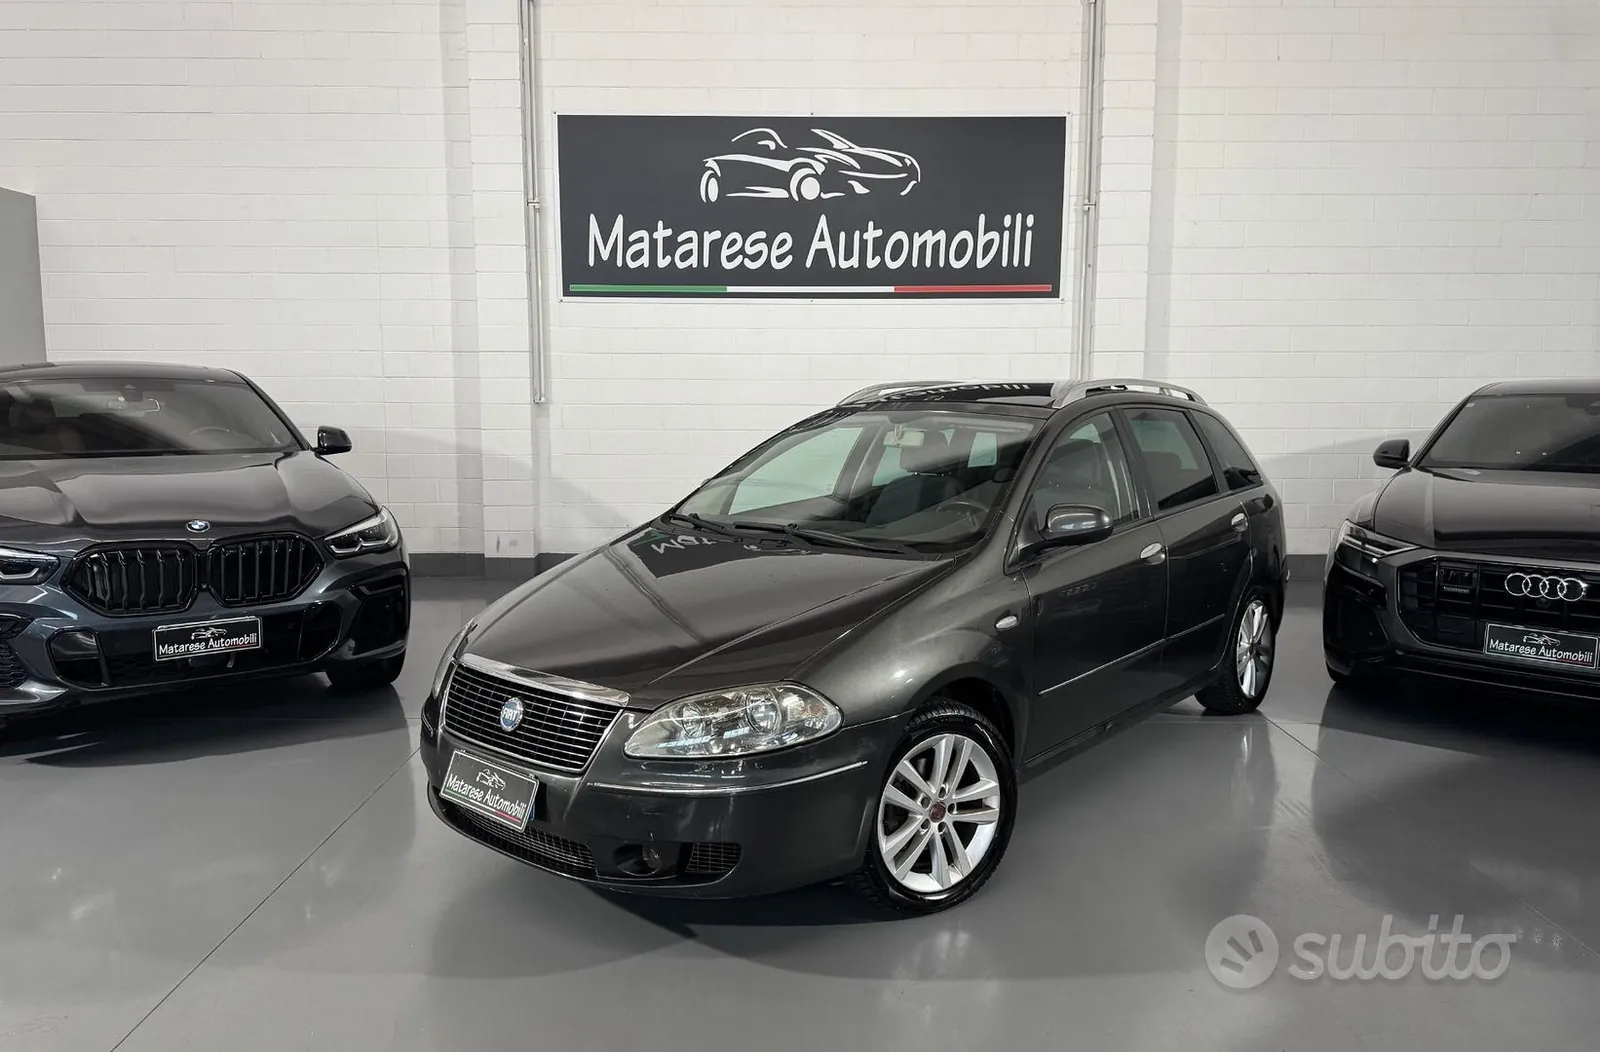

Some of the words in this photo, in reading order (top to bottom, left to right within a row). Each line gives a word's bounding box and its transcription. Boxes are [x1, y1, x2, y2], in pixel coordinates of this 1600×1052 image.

[588, 213, 793, 270] Matarese
[805, 212, 1034, 270] Automobili
[159, 640, 206, 655] Matarese
[207, 633, 258, 649] Automobili
[1489, 638, 1537, 655] Matarese
[1538, 645, 1593, 663] Automobili
[501, 707, 519, 721] FIAT
[446, 773, 483, 802] Matarese
[482, 788, 527, 819] Automobili
